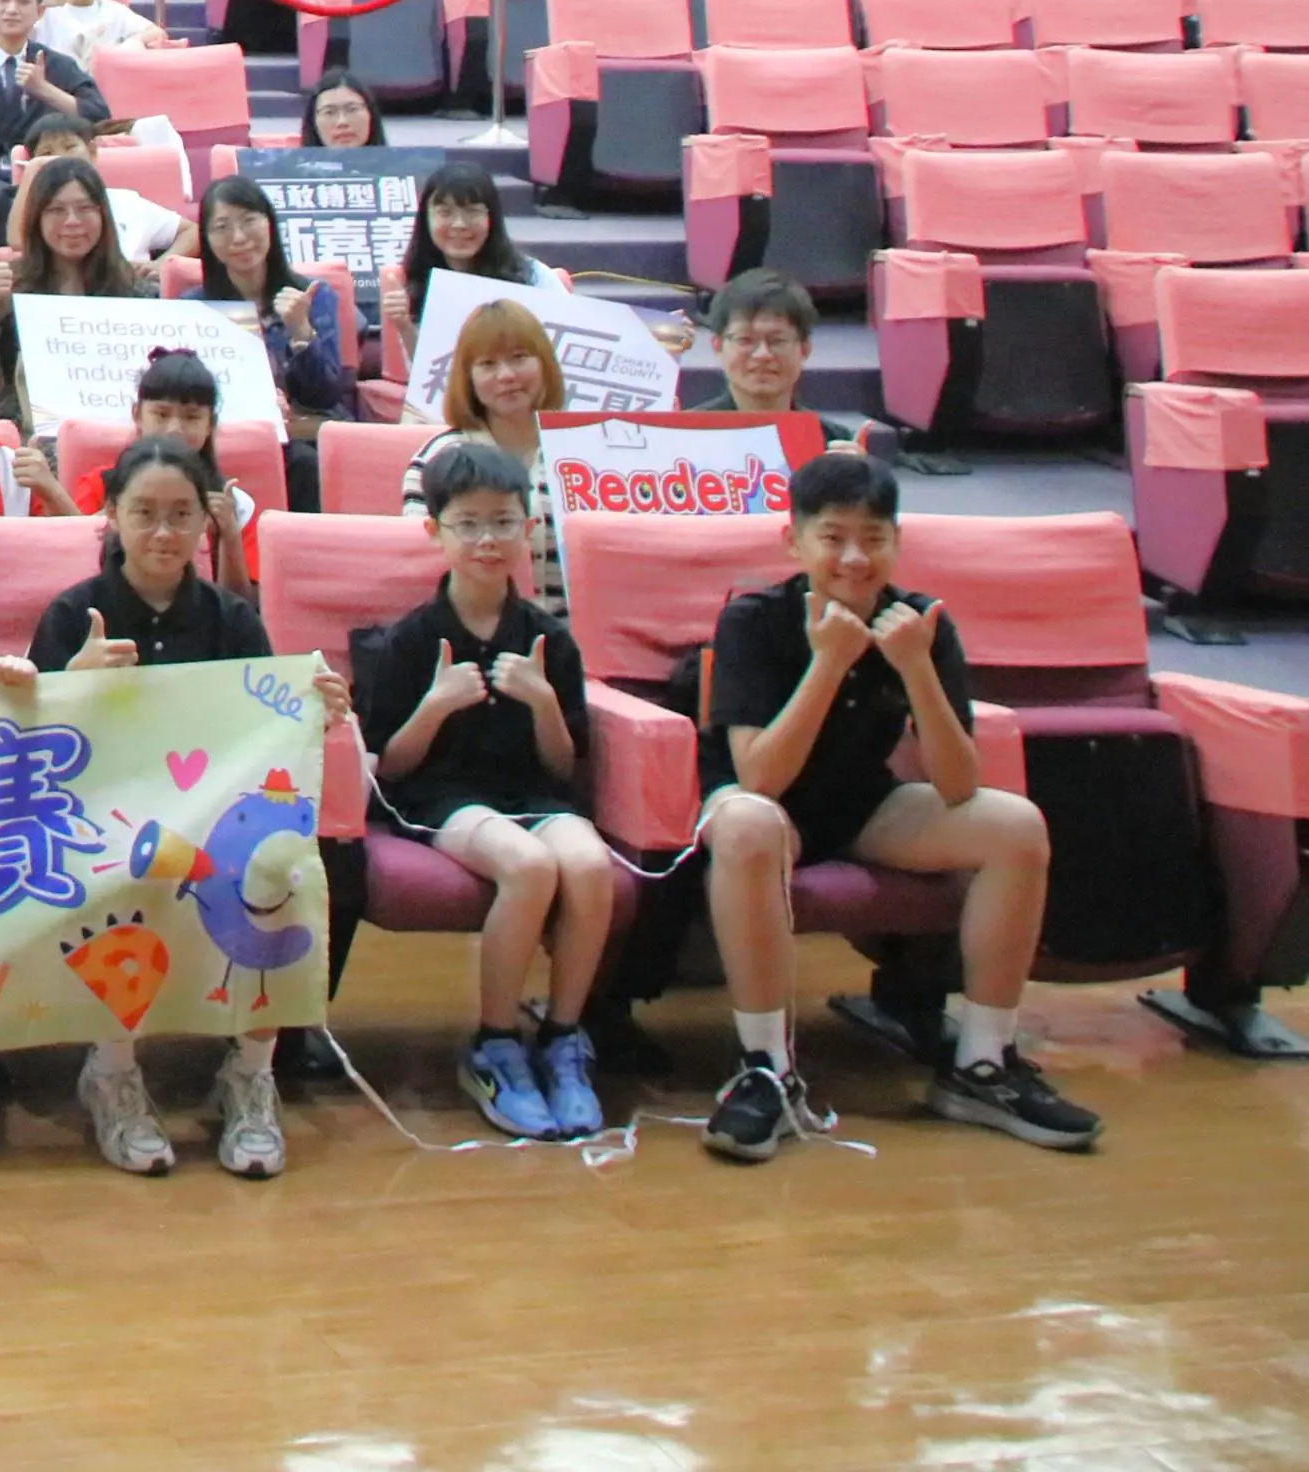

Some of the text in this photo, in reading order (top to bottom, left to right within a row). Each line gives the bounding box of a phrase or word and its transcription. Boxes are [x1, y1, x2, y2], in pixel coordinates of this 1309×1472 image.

[59, 317, 220, 339] Endeavor to
[46, 337, 87, 356] the
[611, 364, 663, 381] COUNTY
[555, 455, 792, 513] Reader's
